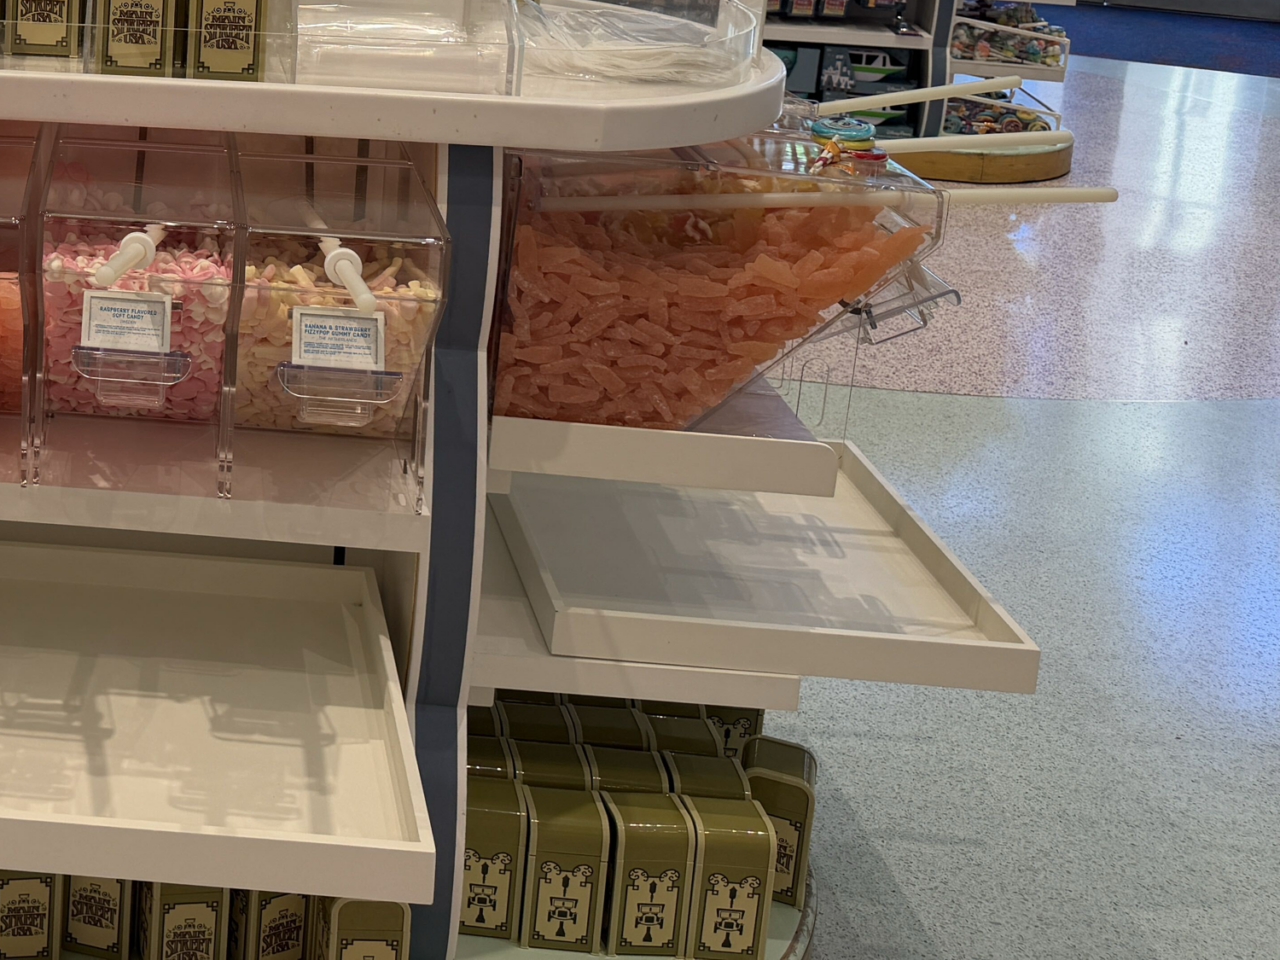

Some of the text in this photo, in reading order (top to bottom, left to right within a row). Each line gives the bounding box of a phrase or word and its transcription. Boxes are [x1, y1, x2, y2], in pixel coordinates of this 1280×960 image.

[20, 0, 66, 18] STREET
[118, 10, 154, 19] MAIN
[31, 12, 52, 23] USA
[211, 15, 246, 24] MAIN
[112, 18, 160, 40] STREET
[204, 24, 253, 45] STREET
[123, 34, 146, 46] USA
[215, 38, 239, 50] USA
[335, 325, 371, 333] STRAWBERRY
[78, 893, 111, 906] MAIN
[7, 906, 40, 914] MAIN
[71, 900, 117, 926] STREET
[0, 913, 46, 933] STREET
[82, 916, 104, 928] USA
[12, 927, 34, 936] USA
[172, 931, 206, 939] MAIN
[166, 938, 212, 958] STREET
